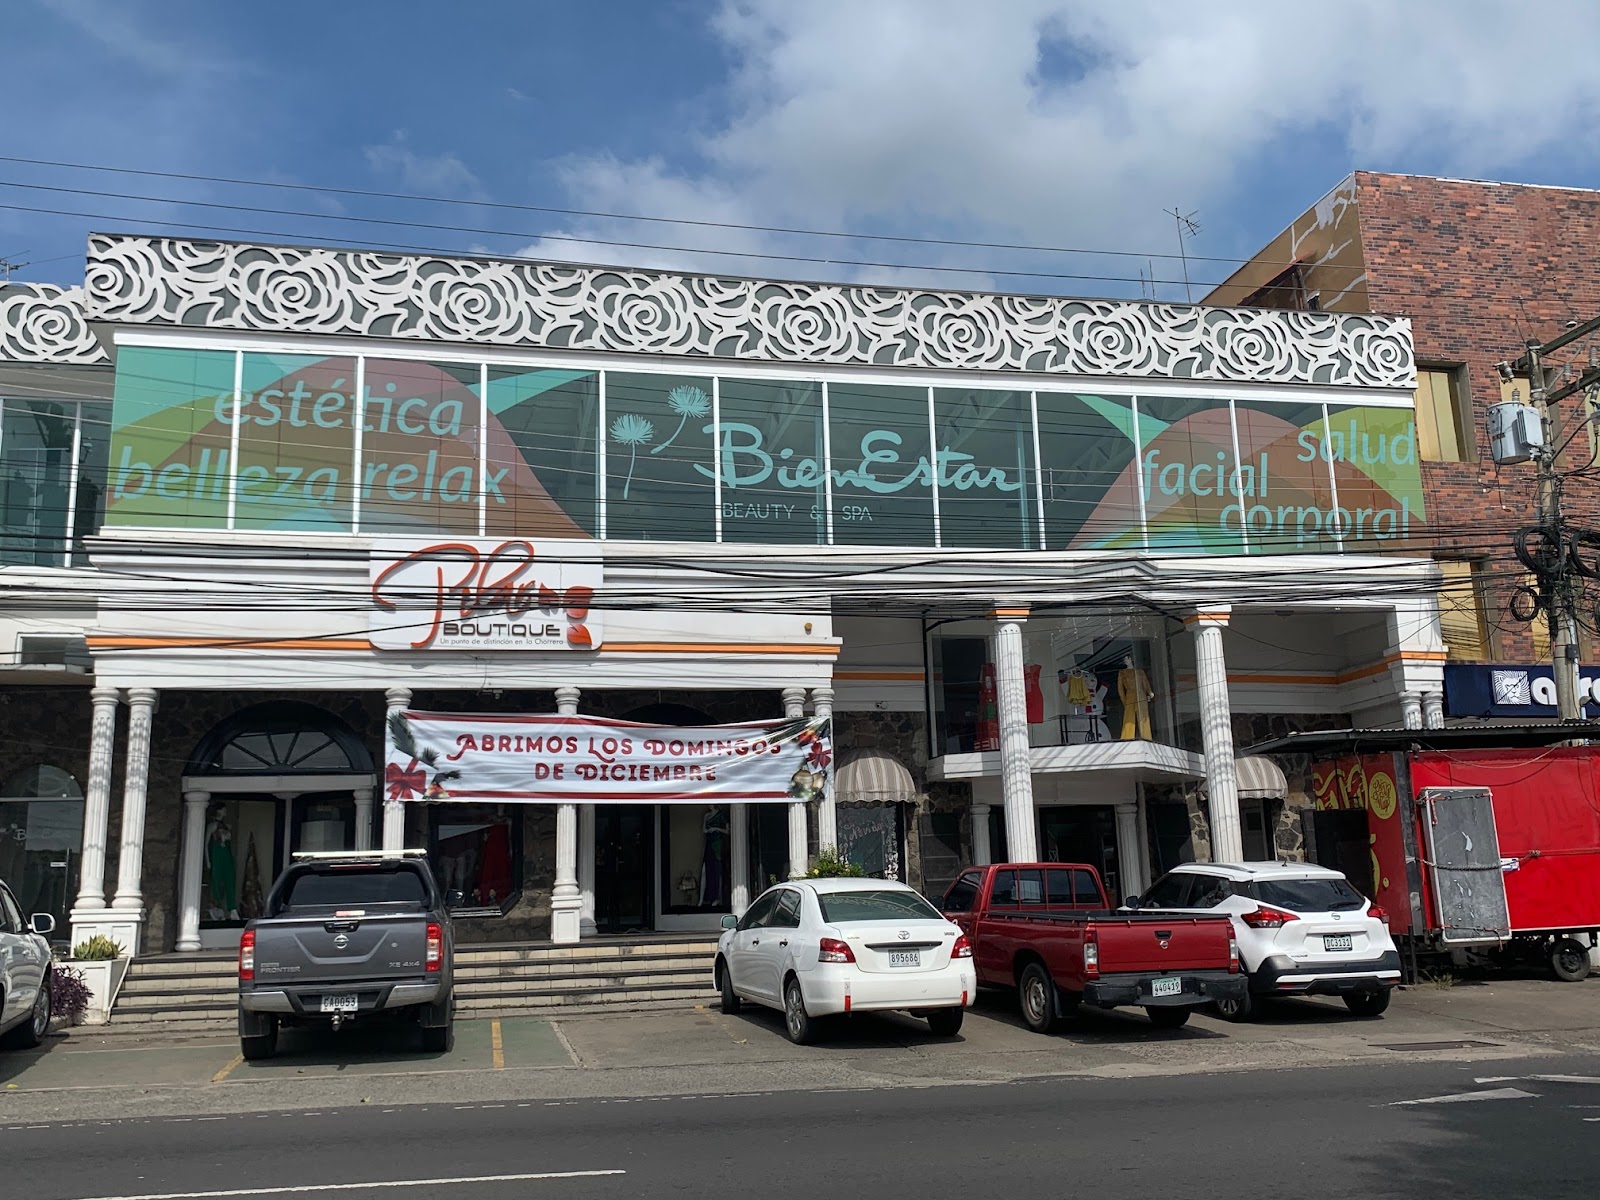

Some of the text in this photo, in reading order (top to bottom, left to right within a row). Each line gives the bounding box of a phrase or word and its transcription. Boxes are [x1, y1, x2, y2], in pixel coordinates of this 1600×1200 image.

[213, 379, 464, 435] estética
[1297, 419, 1414, 465] salud
[693, 422, 1023, 493] BienEstar
[114, 446, 510, 504] belleza relax
[1142, 449, 1268, 501] facial
[722, 503, 873, 522] BEAUTY & SPA
[1220, 496, 1409, 548] corporal
[443, 623, 561, 637] BOUTIQUE
[451, 638, 470, 646] punto
[447, 734, 782, 763] ABRIMOS LOS DOMINGOS
[535, 763, 716, 781] DE DICIEMBRE
[891, 953, 919, 962] 895686
[1154, 981, 1180, 993] 440419
